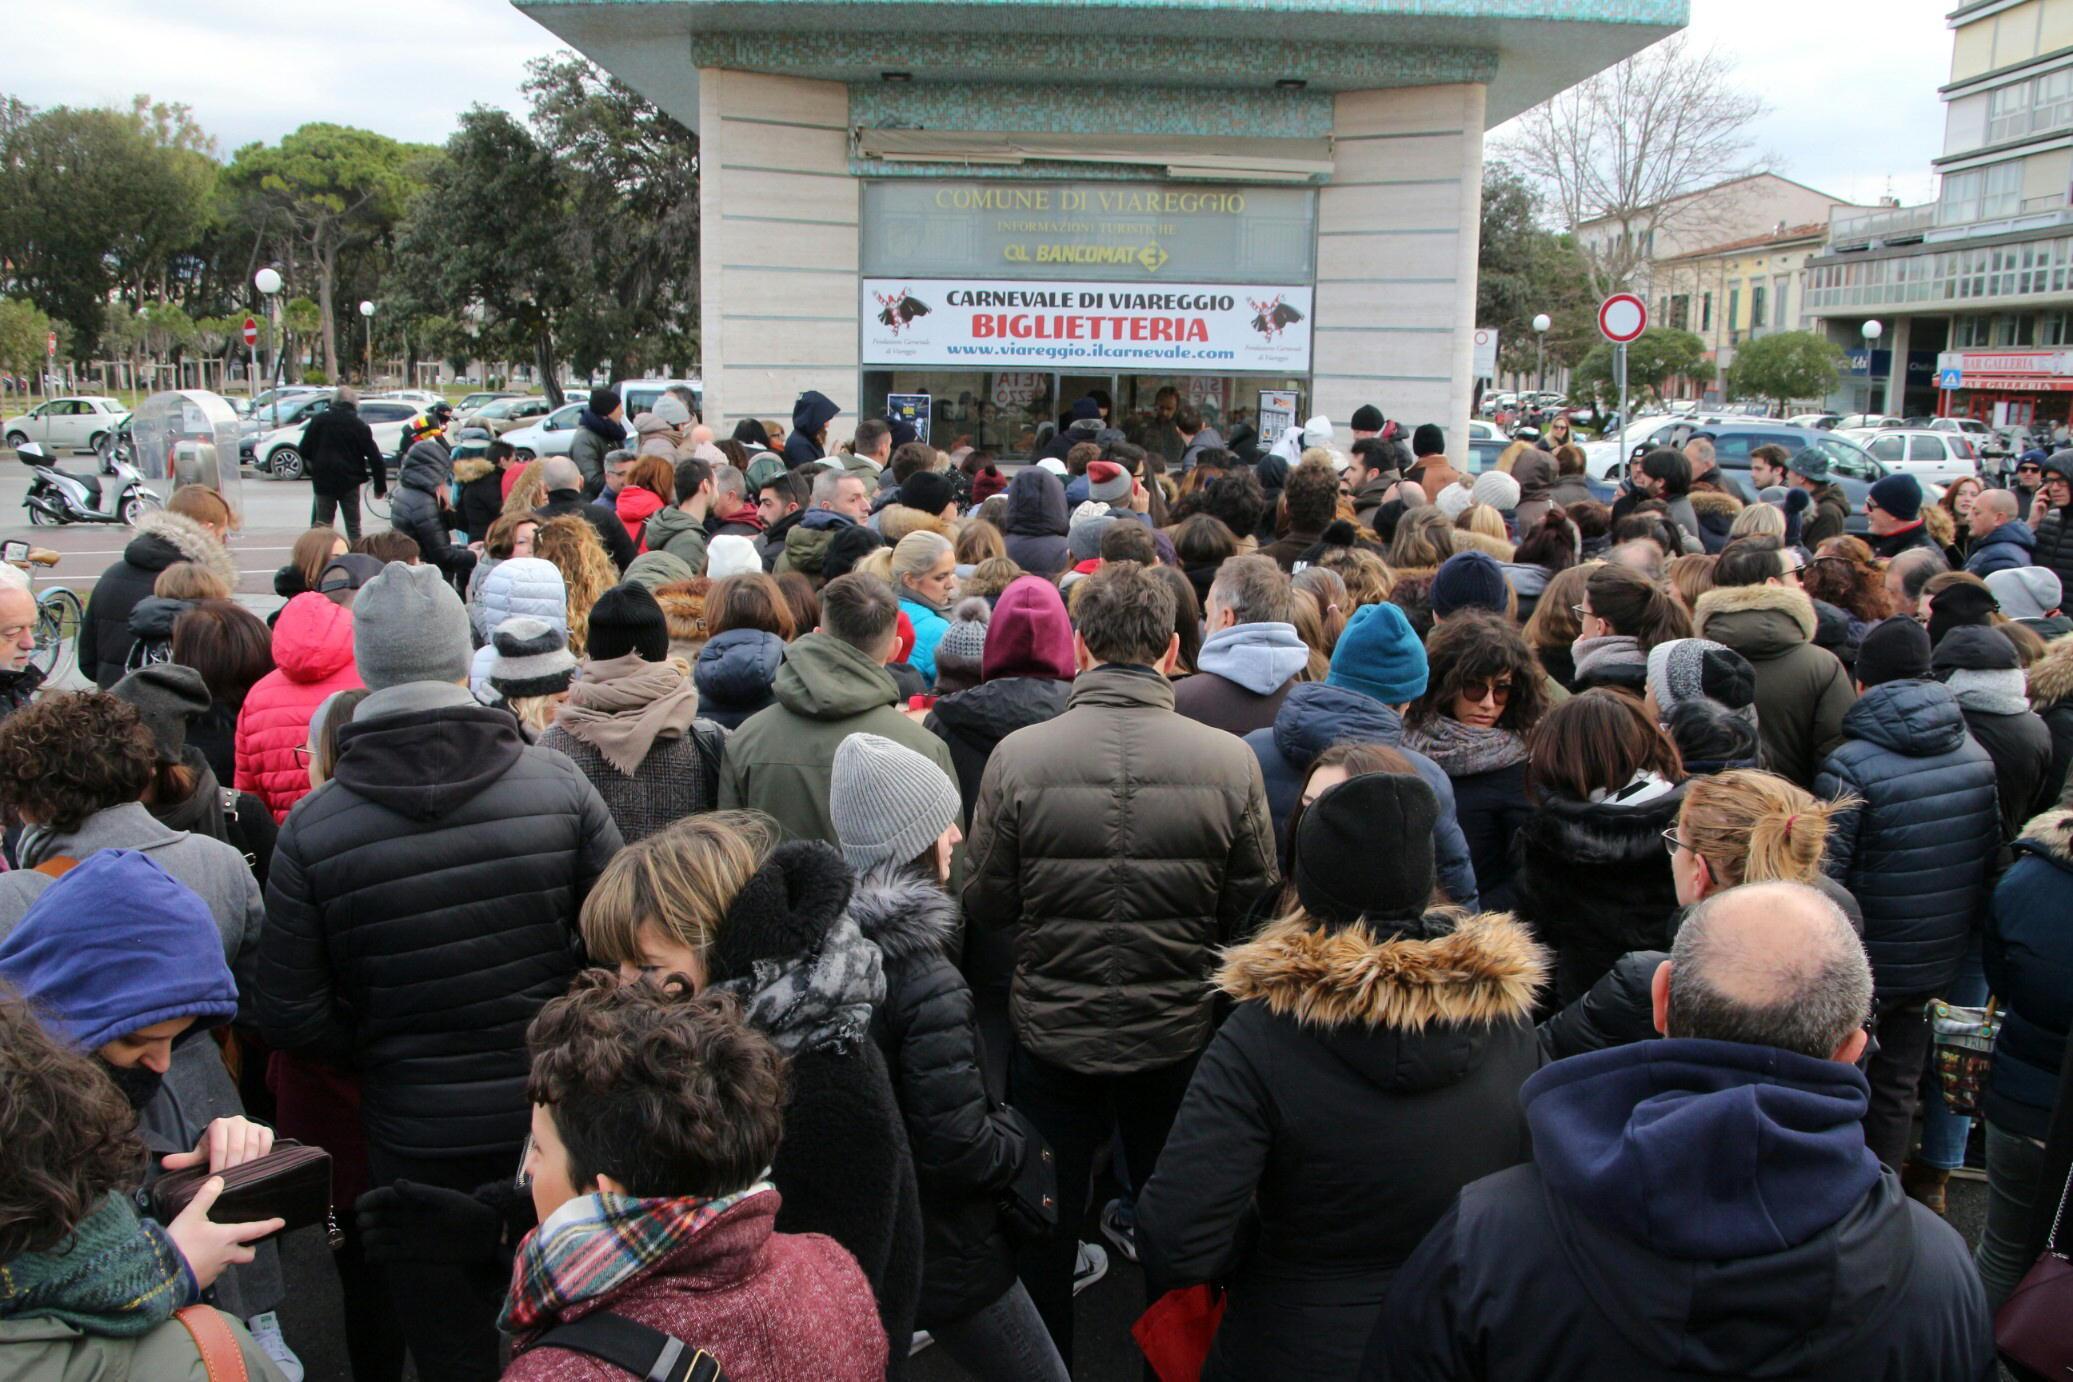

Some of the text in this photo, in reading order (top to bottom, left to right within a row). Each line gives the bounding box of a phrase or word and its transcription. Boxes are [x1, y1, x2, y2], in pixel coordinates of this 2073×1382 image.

[935, 189, 1246, 214] COMUNE DI VIAREGGIO
[1036, 244, 1137, 264] BANCOMAT
[946, 290, 1235, 311] CARNEVALE DI VIAREGGIO
[972, 313, 1209, 342] BIGLIETTERIA
[946, 342, 1235, 360] www.viareggio.ilcarnevale.com
